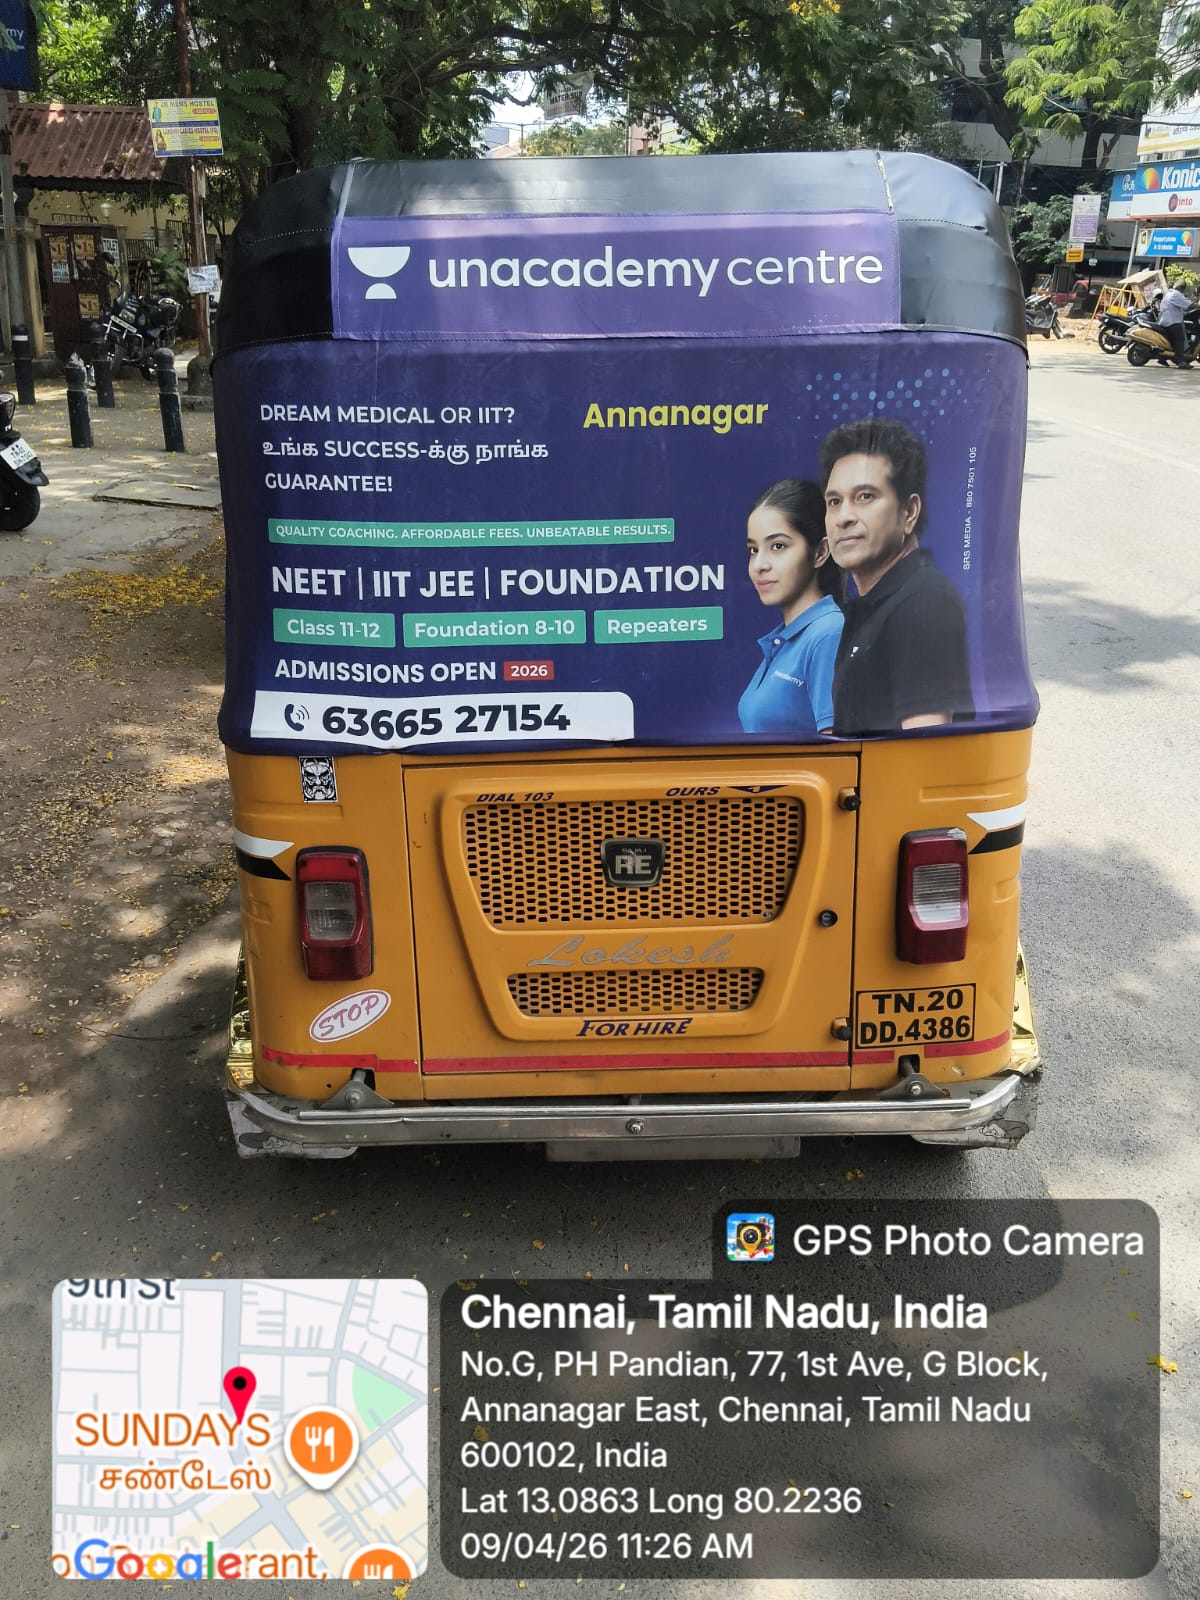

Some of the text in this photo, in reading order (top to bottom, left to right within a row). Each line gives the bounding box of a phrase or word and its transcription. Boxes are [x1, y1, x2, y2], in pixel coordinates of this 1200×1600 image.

[189, 99, 215, 107] HOSTEL
[428, 245, 883, 297] unacademy centre
[260, 404, 515, 424] DREAM MEDICAL OR IIT?
[583, 402, 769, 435] Annanagar
[262, 437, 549, 465] உங்க SUCCESS-க்கு நாங்க
[969, 446, 977, 464] 105
[265, 472, 393, 492] GUARANTEE!
[276, 523, 671, 540] QUALITY COACHING. AFFORDABLE FEES. UNBEATABLE RESULTS.
[964, 516, 972, 548] MEDIA
[963, 550, 971, 570] SRS
[272, 566, 347, 596] NEET
[373, 570, 411, 598] IIT
[419, 570, 475, 598] JEE
[500, 564, 725, 596] FOUNDATION
[287, 619, 381, 638] Class 11-12
[415, 619, 575, 639] Foundation 8-10
[607, 618, 708, 638] Repeaters
[274, 658, 548, 684] ADMISSIONS OPEN 2026
[322, 703, 571, 741] 63665 27154
[476, 791, 554, 802] DIAL 103
[665, 786, 721, 797] OURS
[615, 854, 652, 875] RE
[528, 934, 735, 967] Lokesh
[871, 988, 964, 1015] TN.20
[318, 994, 380, 1037] STOP
[633, 1017, 693, 1036] HIRE
[860, 1015, 971, 1045] DD.4386
